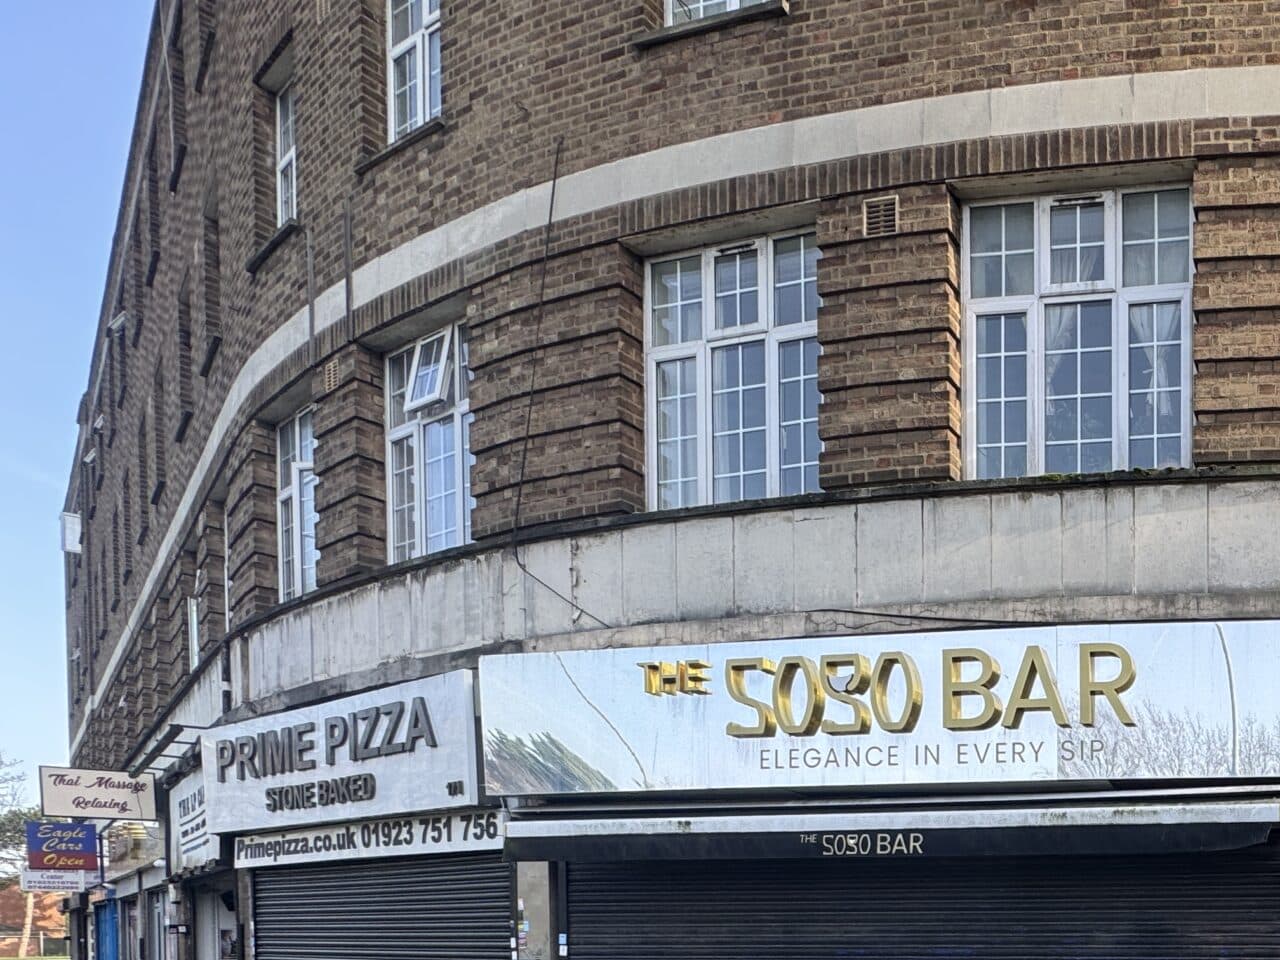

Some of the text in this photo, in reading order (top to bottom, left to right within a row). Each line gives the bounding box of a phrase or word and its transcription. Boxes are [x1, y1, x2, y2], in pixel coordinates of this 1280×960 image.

[637, 642, 1138, 738] THE SOSO BAR
[216, 696, 439, 784] PRIME PIZZA
[759, 739, 1105, 770] ELEGANCE IN EVERY SIP
[48, 774, 148, 793] Thai Massage
[265, 772, 377, 813] STONE BAKED
[72, 796, 133, 813] Relaxing
[37, 825, 87, 838] Eagle
[236, 826, 358, 863] Primepizza.co.uk
[361, 819, 414, 849] 01923
[418, 816, 452, 846] 751
[460, 811, 498, 842] 756
[42, 838, 83, 852] Cars
[800, 832, 924, 856] THE SOSO BAR
[43, 854, 85, 867] Open
